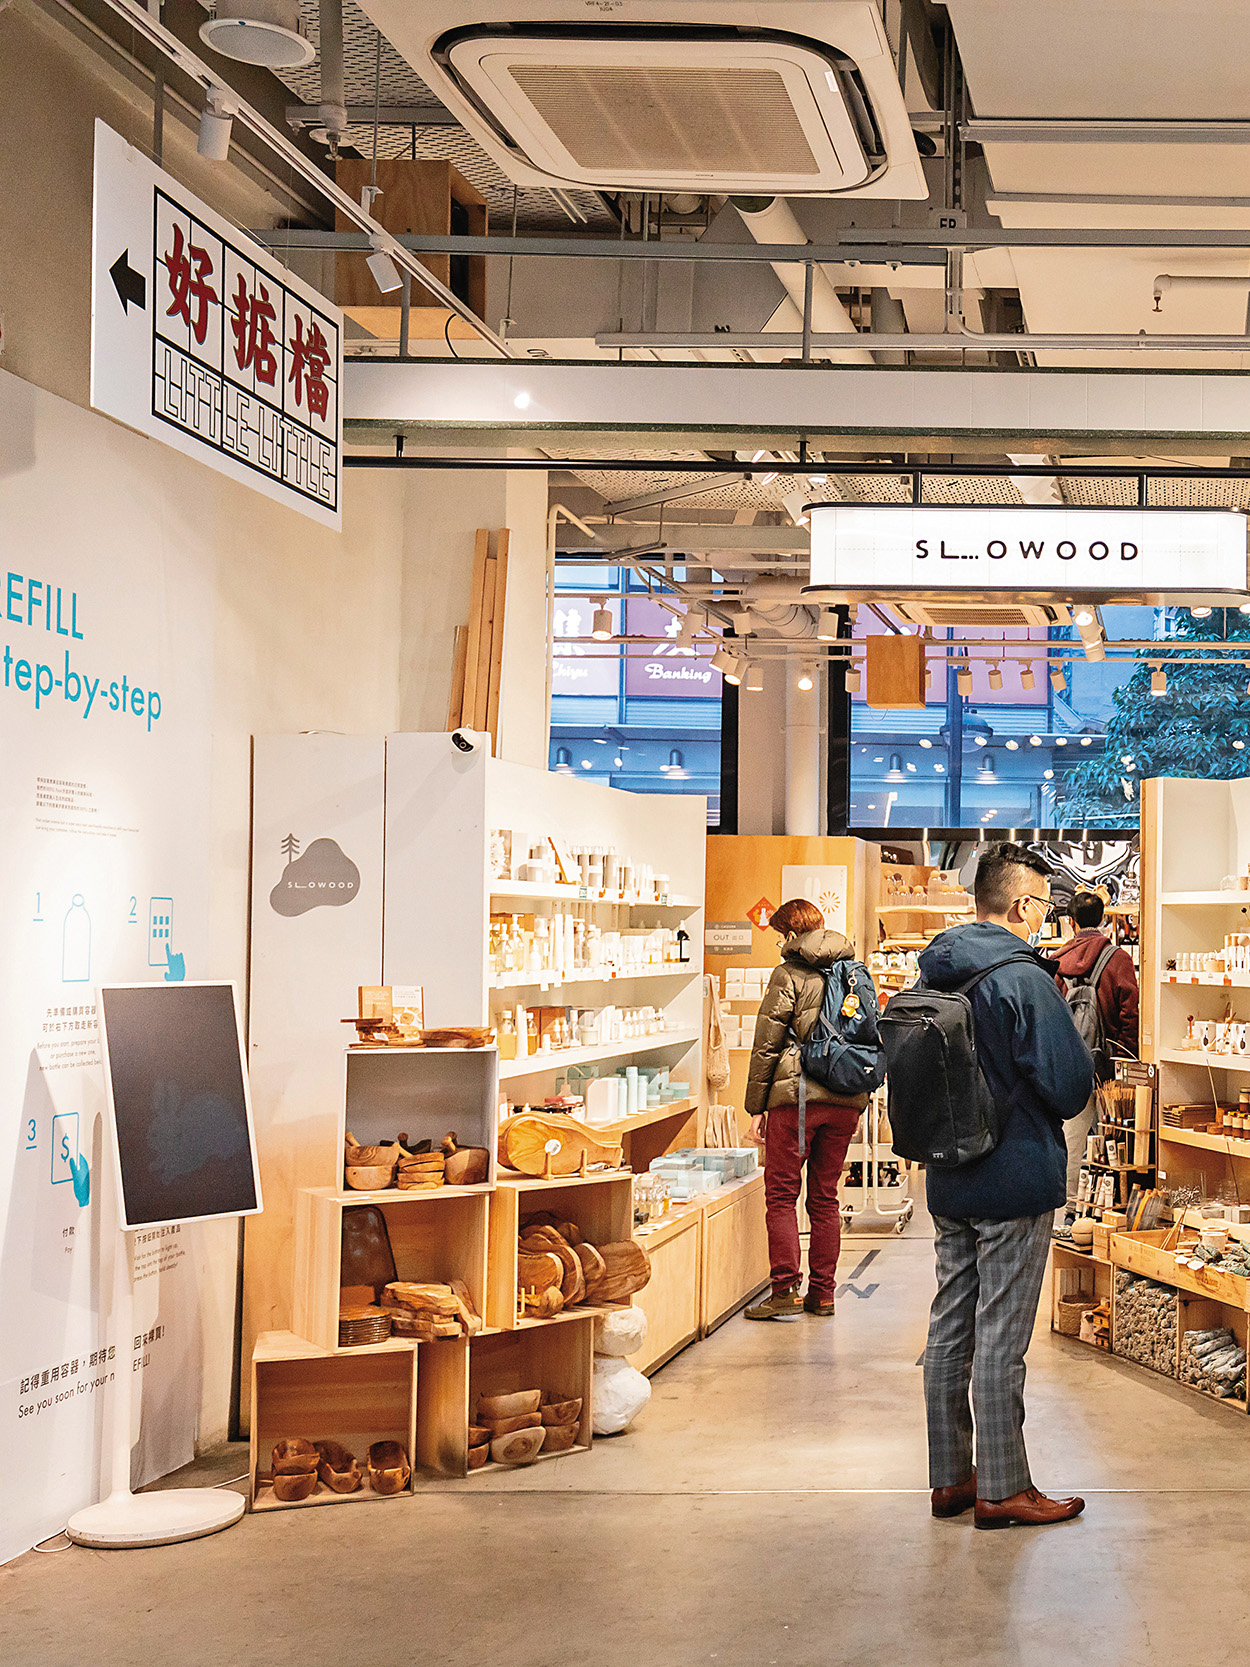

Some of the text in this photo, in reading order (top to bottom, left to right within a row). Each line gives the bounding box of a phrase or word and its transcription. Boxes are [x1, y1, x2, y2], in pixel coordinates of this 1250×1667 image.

[164, 347, 331, 500] LITTLE LITTLE
[0, 571, 84, 640] EFILL
[4, 645, 161, 732] tep-by-step
[644, 663, 712, 683] Banking
[129, 895, 137, 916] 2
[27, 1118, 37, 1142] 3
[18, 1404, 35, 1419] See
[36, 1398, 53, 1415] you
[54, 1388, 75, 1404] soon
[76, 1380, 88, 1395] for
[89, 1376, 107, 1393] your
[132, 1353, 151, 1372] EFILL!
